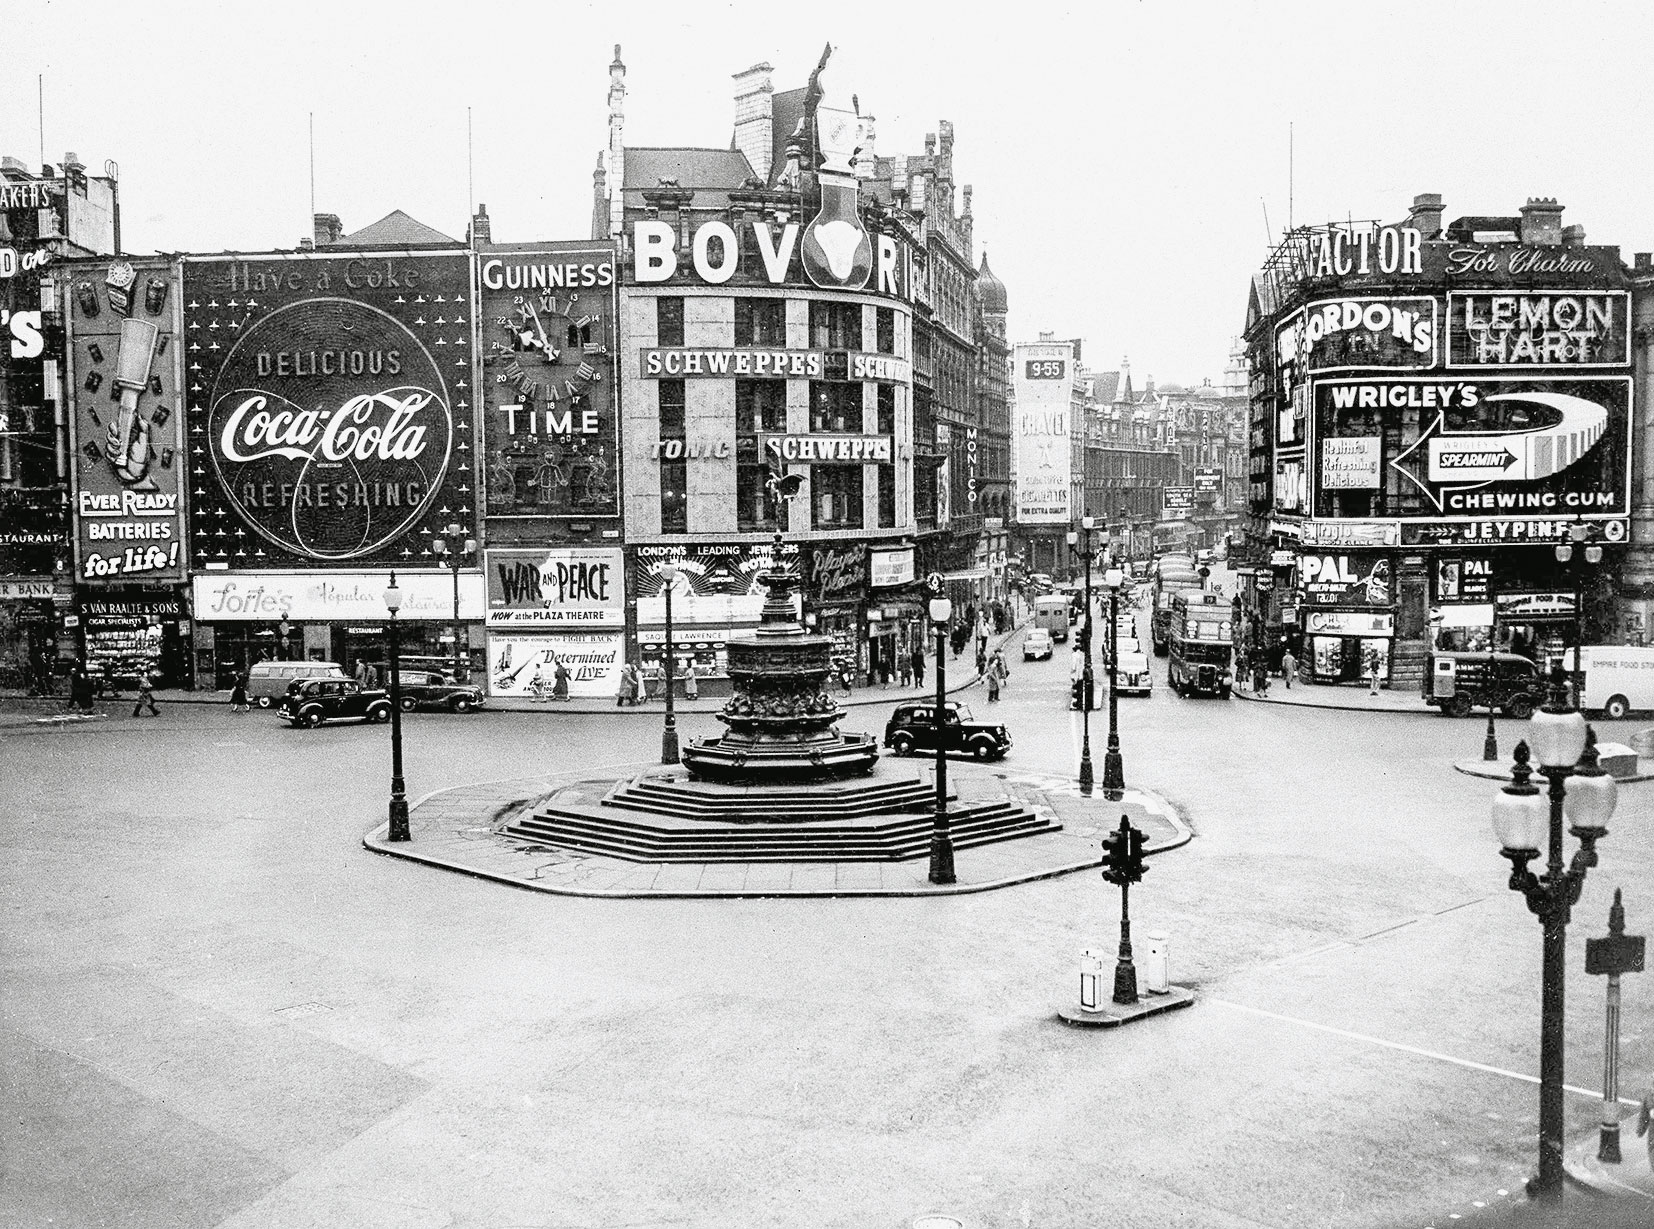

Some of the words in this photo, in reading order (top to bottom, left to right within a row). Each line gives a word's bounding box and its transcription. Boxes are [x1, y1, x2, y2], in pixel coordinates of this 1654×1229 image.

[1309, 227, 1423, 277] FACTOR
[1445, 248, 1498, 275] For
[1508, 249, 1594, 275] Charm
[230, 262, 302, 292] Have
[317, 270, 330, 291] a
[344, 260, 421, 290] Coke
[483, 259, 613, 289] GUINNESS
[514, 296, 523, 304] 23
[497, 316, 507, 325] 22
[1466, 297, 1612, 329] LEMON
[1479, 330, 1597, 363] HART
[257, 349, 402, 377] DELICIOUS
[646, 350, 821, 376] SCHWEPPES
[497, 374, 507, 383] 20
[1332, 382, 1478, 408] WRIGLEY'S
[221, 393, 434, 463] Coca-Cola
[499, 404, 599, 435] TIME
[650, 439, 730, 460] TONIC
[766, 437, 890, 461] SCHWEPPES
[1323, 440, 1369, 455] Healthful
[966, 428, 978, 502] MONICO
[1323, 456, 1377, 474] Refreshing
[1440, 453, 1509, 467] SPEARMINT
[1323, 472, 1370, 488] Delicious
[80, 491, 122, 516] EVER
[122, 491, 177, 516] READY
[242, 482, 422, 508] REFRESHING
[1450, 493, 1558, 509] CHEWING
[1565, 492, 1615, 508] GUM
[89, 522, 171, 539] BATTERIES
[84, 553, 121, 577] for
[122, 542, 179, 573] life!
[637, 545, 687, 557] LONDON'S
[697, 545, 740, 556] LEADING
[748, 544, 799, 556] JEWEERS
[1303, 556, 1358, 583] PAL
[1464, 560, 1493, 575] PAL
[18, 584, 50, 595] BANK
[498, 561, 543, 606] WAR
[542, 571, 558, 587] AND
[556, 561, 611, 604] PEACE
[90, 604, 107, 613] VAN
[109, 603, 142, 613] RAALTE
[153, 603, 179, 613] SONS
[491, 611, 514, 620] NOW
[522, 612, 532, 620] the
[533, 611, 564, 620] PLAZA
[566, 610, 604, 620] THEATRE
[563, 634, 586, 642] FIGHT
[680, 632, 722, 640] LAWRENCE
[1592, 660, 1617, 669] EMPIRE
[1620, 661, 1639, 670] FOOD
